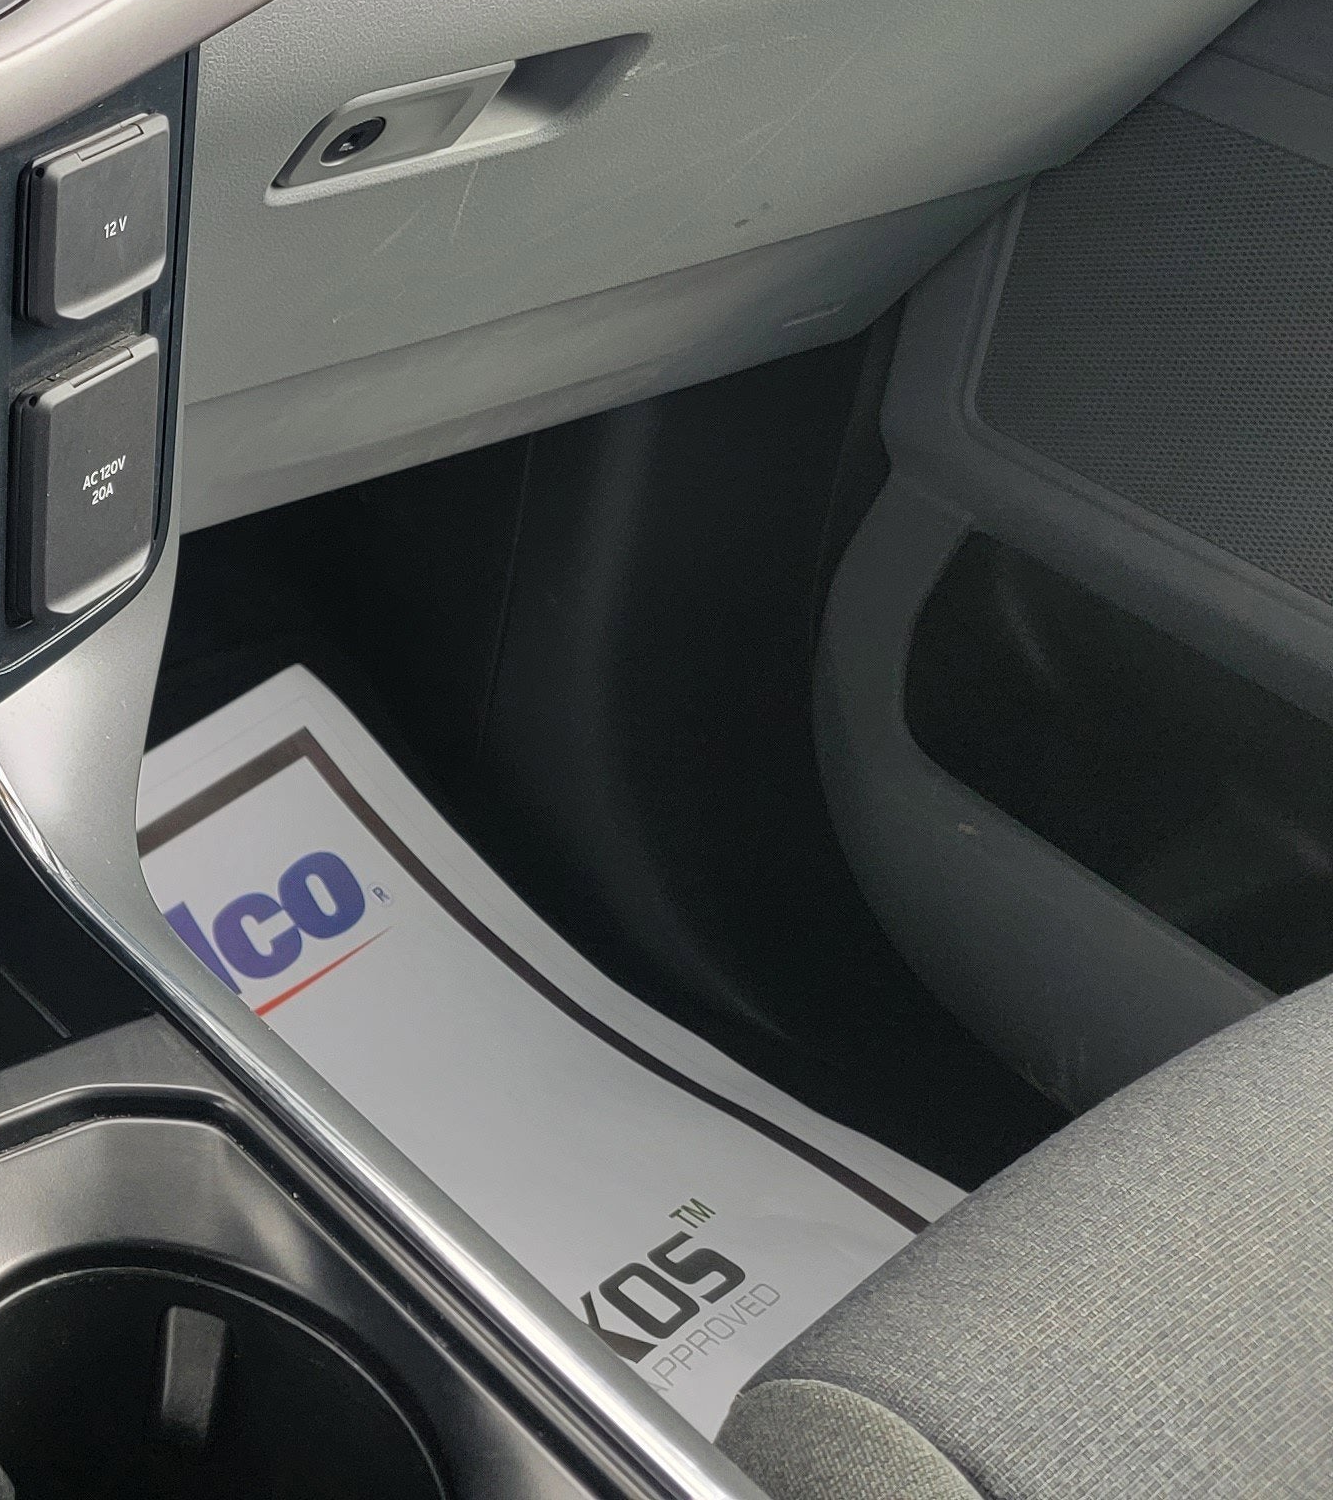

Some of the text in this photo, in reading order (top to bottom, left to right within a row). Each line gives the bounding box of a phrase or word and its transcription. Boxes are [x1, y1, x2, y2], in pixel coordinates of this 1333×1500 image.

[103, 215, 128, 239] 12 V
[82, 454, 126, 491] AC 120V
[92, 482, 114, 506] 20A
